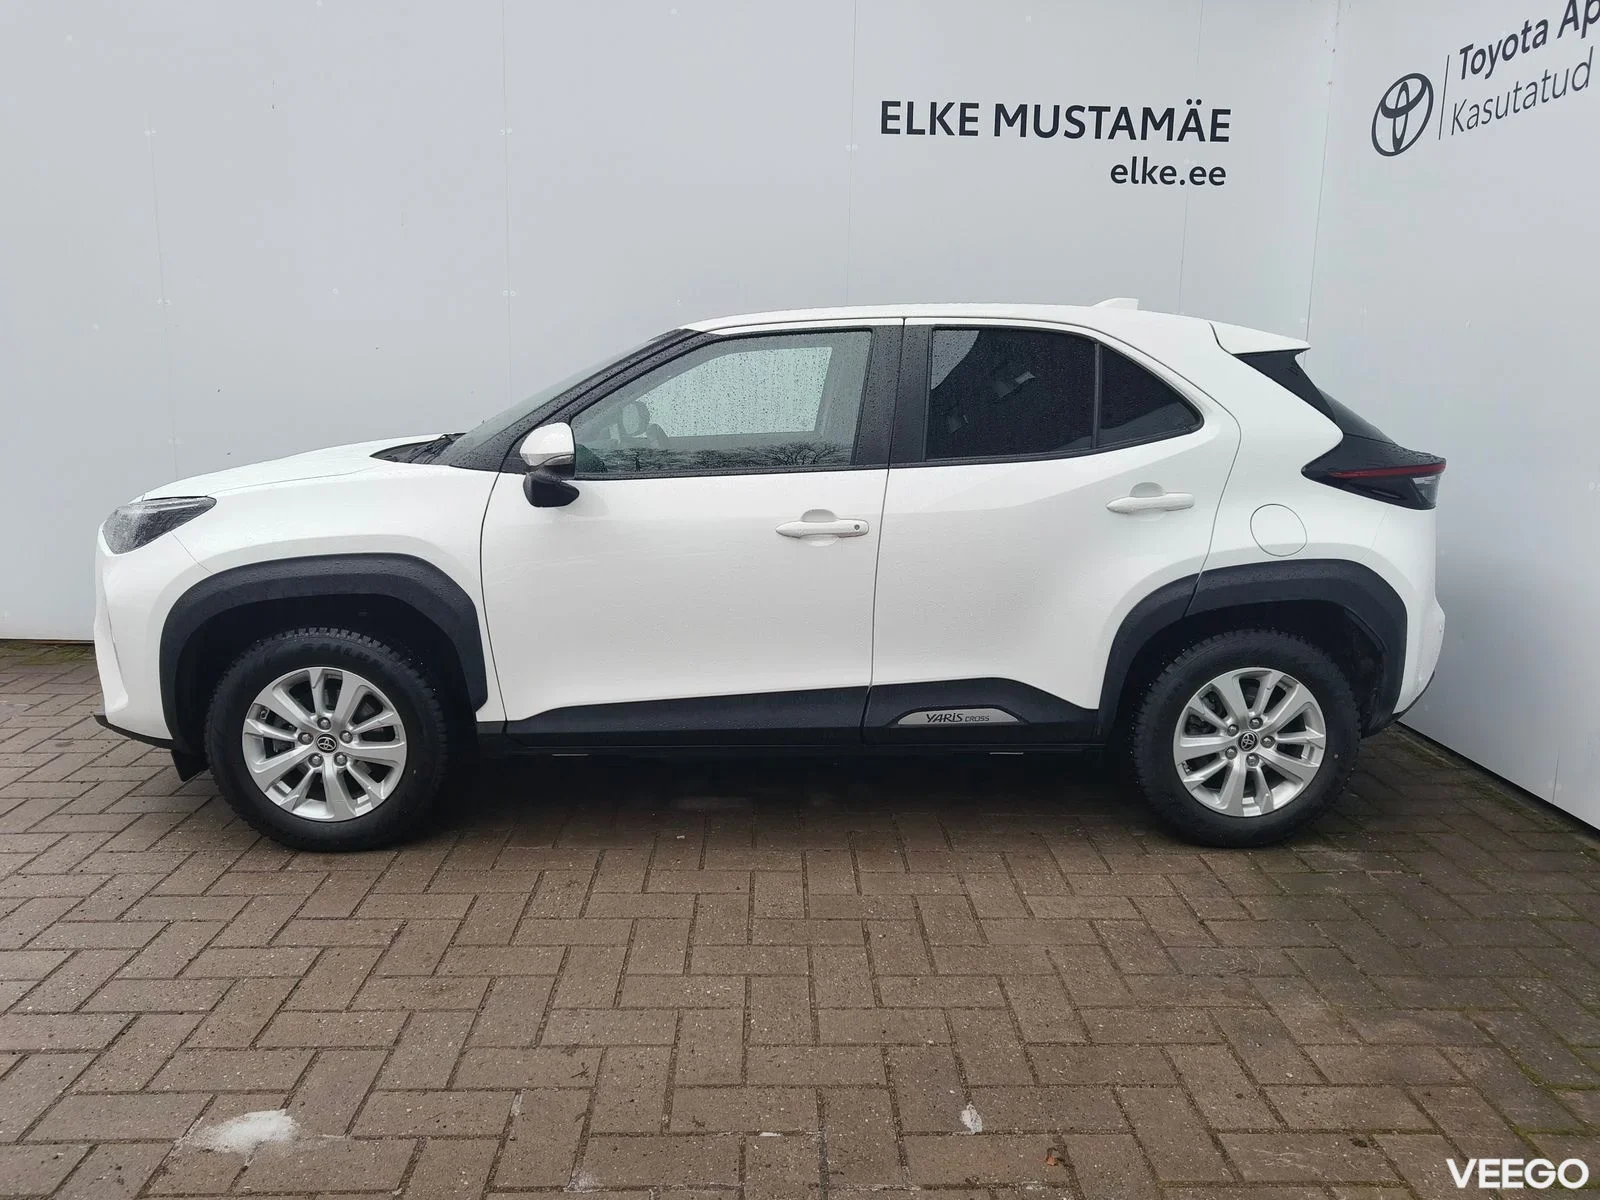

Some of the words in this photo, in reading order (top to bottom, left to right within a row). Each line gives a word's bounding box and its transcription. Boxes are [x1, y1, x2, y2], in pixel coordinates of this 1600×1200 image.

[1459, 19, 1549, 80] Toyota
[1450, 46, 1594, 136] Kasutatud
[880, 100, 980, 137] ELKE
[993, 98, 1232, 143] MUSTAMÄE
[1110, 156, 1227, 186] elke.ee
[926, 712, 964, 723] YARIS
